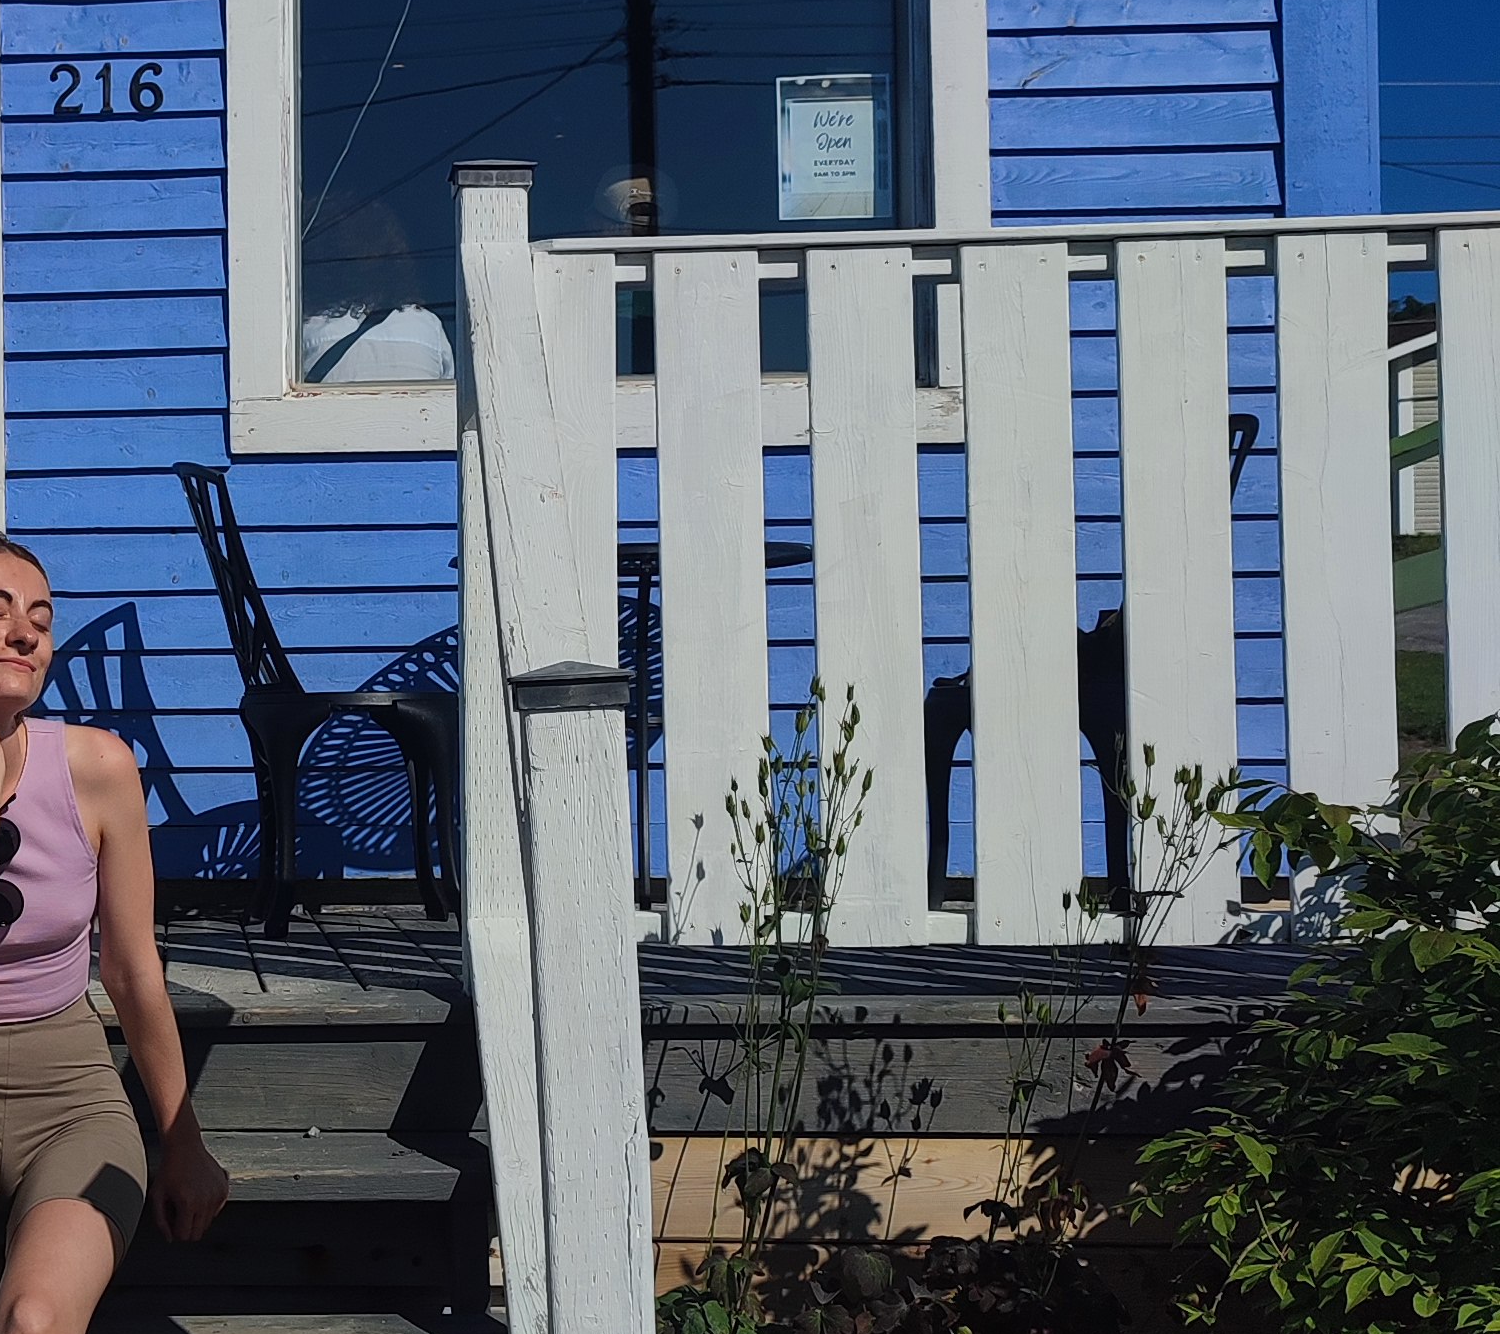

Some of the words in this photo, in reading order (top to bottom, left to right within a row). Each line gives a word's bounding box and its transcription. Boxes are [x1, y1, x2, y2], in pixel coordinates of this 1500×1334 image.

[50, 62, 164, 117] 216
[813, 110, 855, 129] We're
[816, 132, 852, 154] Open
[813, 158, 856, 167] EVERYDAY
